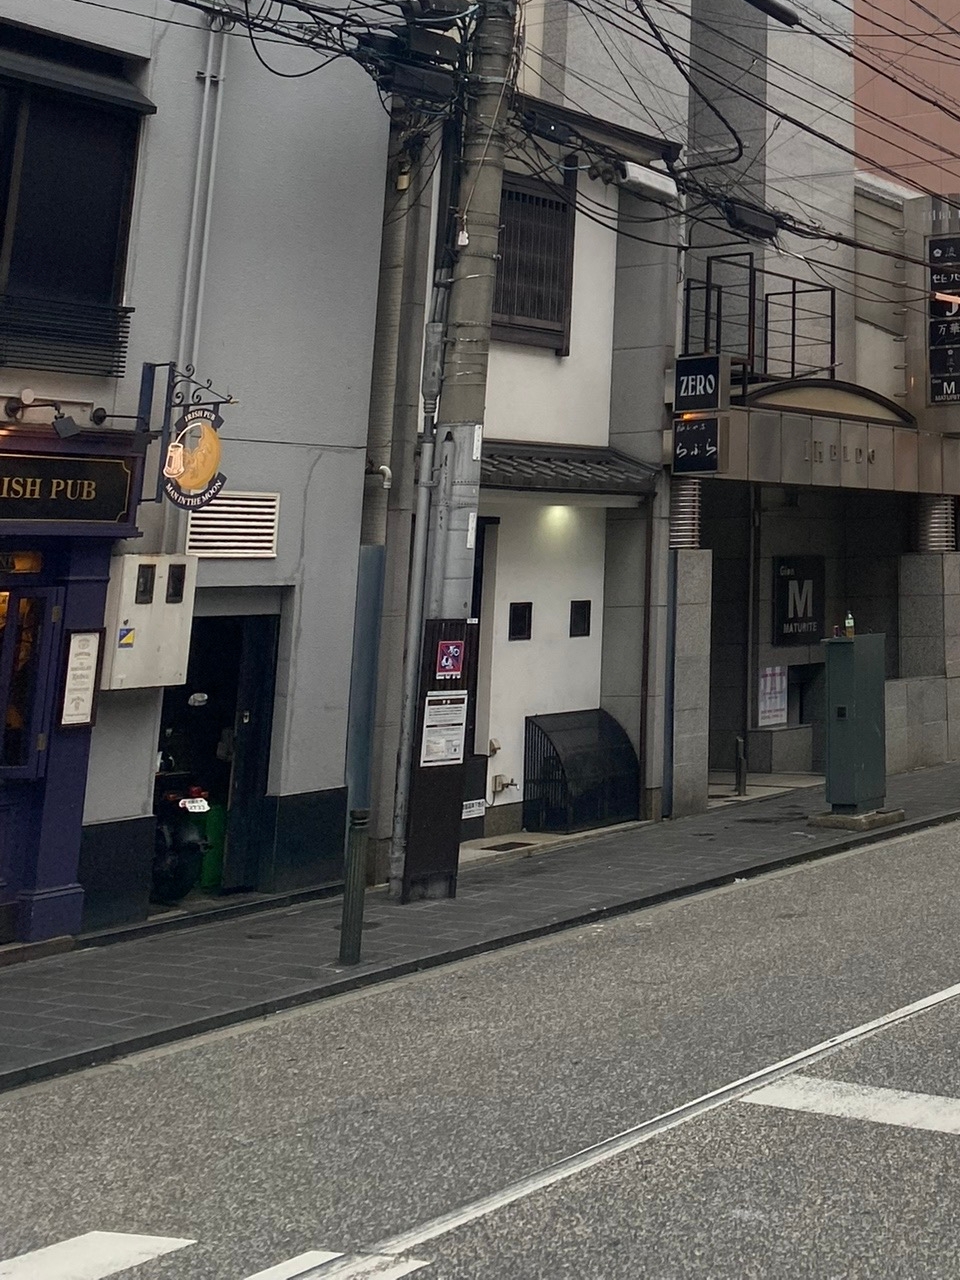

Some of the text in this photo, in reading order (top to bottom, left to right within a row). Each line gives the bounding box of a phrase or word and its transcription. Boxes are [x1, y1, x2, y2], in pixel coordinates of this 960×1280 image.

[680, 373, 716, 397] ZERO
[943, 381, 956, 395] M
[184, 410, 216, 422] IRISH PUB
[0, 476, 97, 500] ISH PUB
[165, 482, 178, 499] MAN
[186, 497, 201, 505] THE
[201, 480, 222, 503] MOON
[788, 579, 814, 618] M
[783, 622, 818, 634] MATURITE
